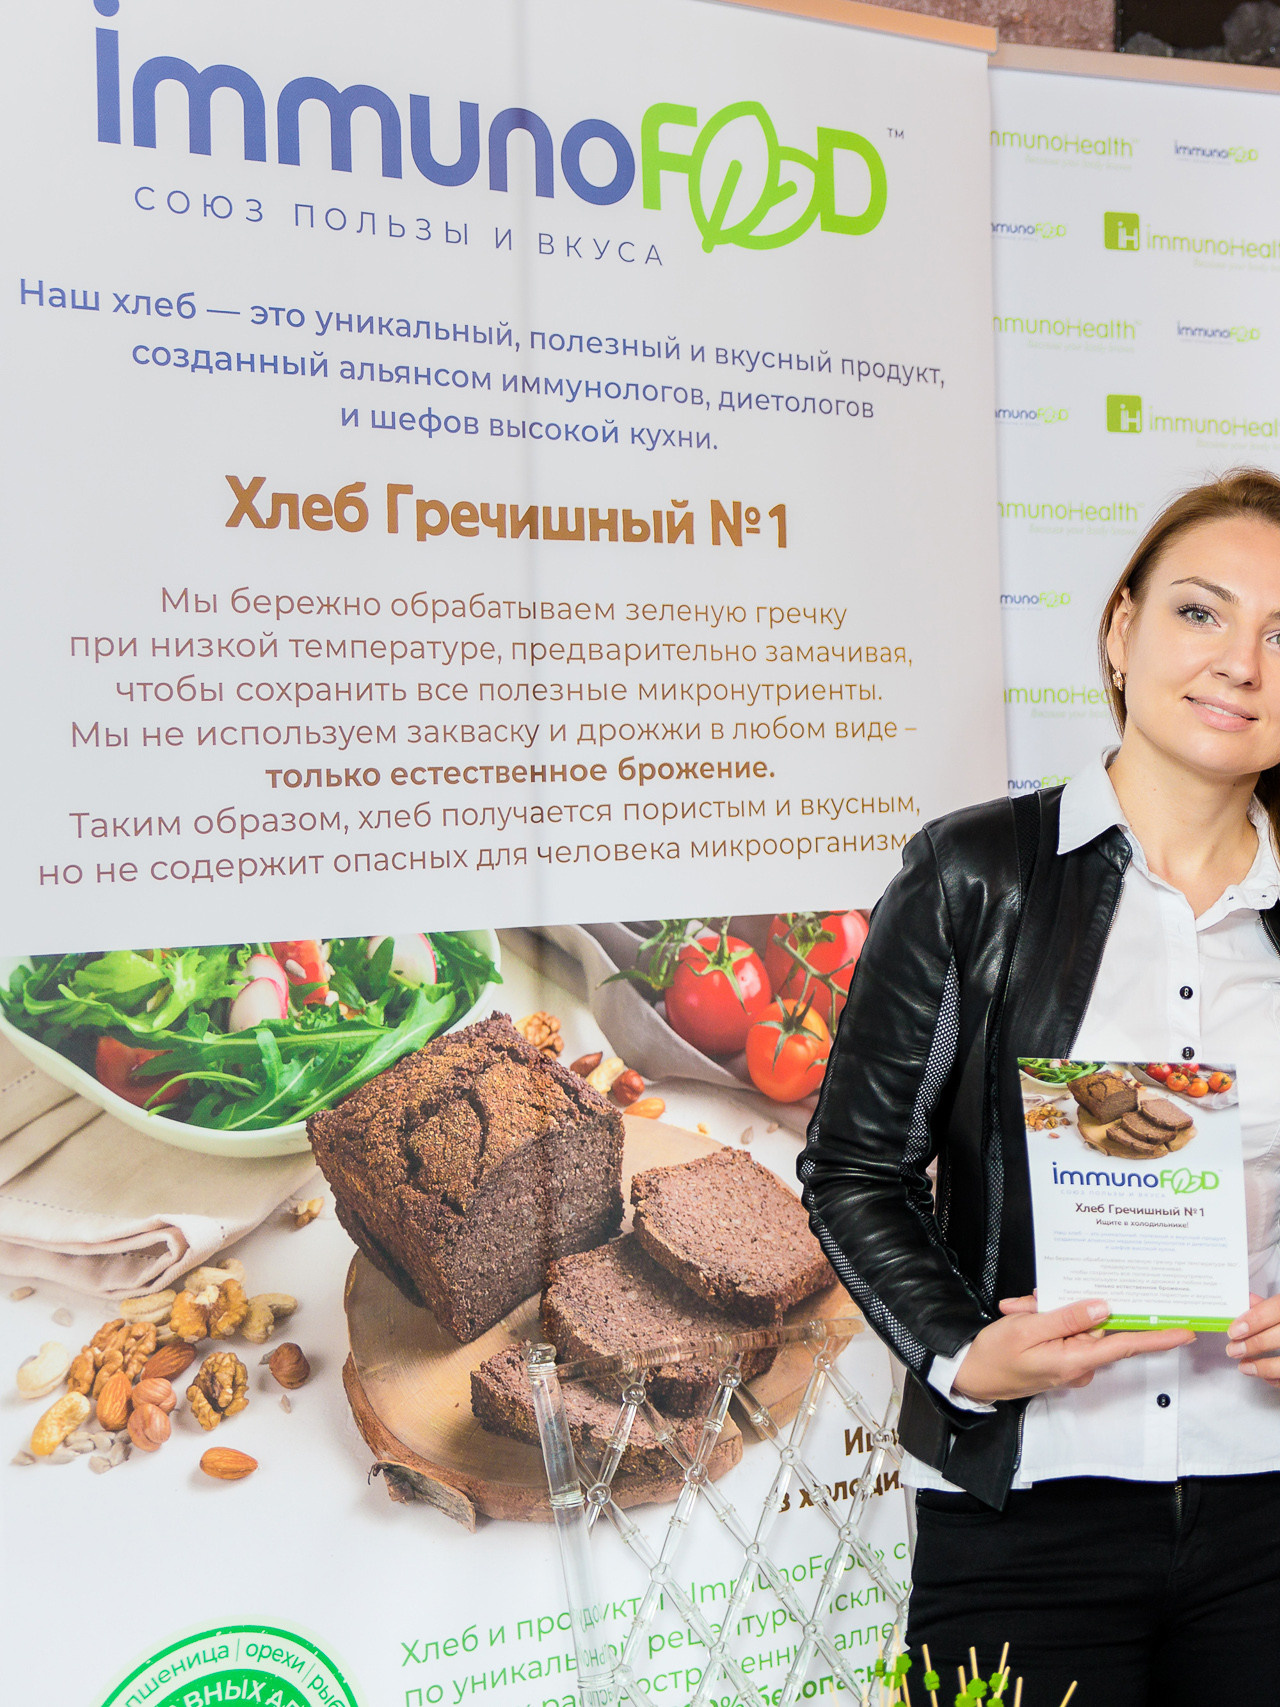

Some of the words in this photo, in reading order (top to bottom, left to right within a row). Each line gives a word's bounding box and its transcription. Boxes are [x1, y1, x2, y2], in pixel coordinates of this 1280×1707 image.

[135, 186, 263, 222] СОЮЗ
[295, 203, 468, 245] ПОЛЬЗЫ
[495, 227, 512, 251] И
[539, 233, 663, 266] ВКУСА
[20, 278, 100, 311] Наш
[112, 292, 196, 319] хлеб
[250, 305, 305, 328] это
[315, 310, 520, 352] уникальный,
[530, 331, 680, 360] полезный
[691, 345, 705, 363] и
[716, 347, 832, 373] вкусный
[842, 358, 944, 389] продукт,
[132, 345, 328, 378] созданный
[340, 361, 491, 390] альянсом
[502, 374, 710, 411] иммунологов,
[718, 391, 874, 418] диетологов
[341, 408, 359, 427] и
[371, 407, 479, 438] шефов
[490, 418, 618, 443] высокой
[631, 427, 717, 451] кухни.
[225, 475, 369, 533] Хлеб
[387, 483, 695, 545] Гречишный
[162, 587, 217, 613] Мы
[231, 586, 381, 621] бережно
[391, 591, 614, 624] обрабатываем
[626, 603, 746, 628] зеленую
[756, 606, 847, 631] гречку
[71, 636, 137, 663] при
[152, 631, 277, 658] низкой
[289, 639, 502, 666] температуре,
[512, 641, 756, 667] предварительно
[765, 645, 912, 667] замачивая,
[116, 674, 223, 702] чтобы
[236, 682, 407, 708] сохранить
[417, 683, 468, 701] все
[480, 683, 627, 701] полезные
[638, 683, 882, 707] микронутриенты.
[72, 721, 128, 747] Мы
[143, 727, 184, 746] не
[198, 725, 396, 751] используем
[408, 724, 540, 748] закваску
[550, 724, 566, 742] и
[577, 723, 700, 747] дрожжи
[711, 723, 724, 739] в
[732, 715, 825, 740] любом
[835, 721, 897, 742] виде
[265, 768, 381, 788] только
[391, 763, 607, 786] естественное
[618, 755, 775, 786] брожение.
[69, 812, 180, 838] Таким
[194, 806, 348, 840] образом,
[358, 801, 431, 829] хлеб
[443, 804, 611, 831] получается
[624, 800, 765, 826] пористым
[776, 799, 790, 816] и
[801, 796, 920, 820] вкусным,
[40, 864, 83, 885] но
[97, 862, 138, 883] не
[151, 855, 324, 884] содержит
[334, 849, 468, 873] опасных
[476, 847, 527, 871] для
[537, 842, 680, 864] человека
[691, 833, 910, 862] микроорганизм
[1075, 1203, 1105, 1213] Хлеб
[1109, 1204, 1180, 1216] Гречишный
[1096, 1219, 1122, 1227] Ищите
[400, 1624, 478, 1666] Хлеб
[489, 1625, 505, 1646] и
[125, 1645, 229, 1707] пшеница
[246, 1643, 305, 1673] орехи
[406, 1684, 444, 1707] по
